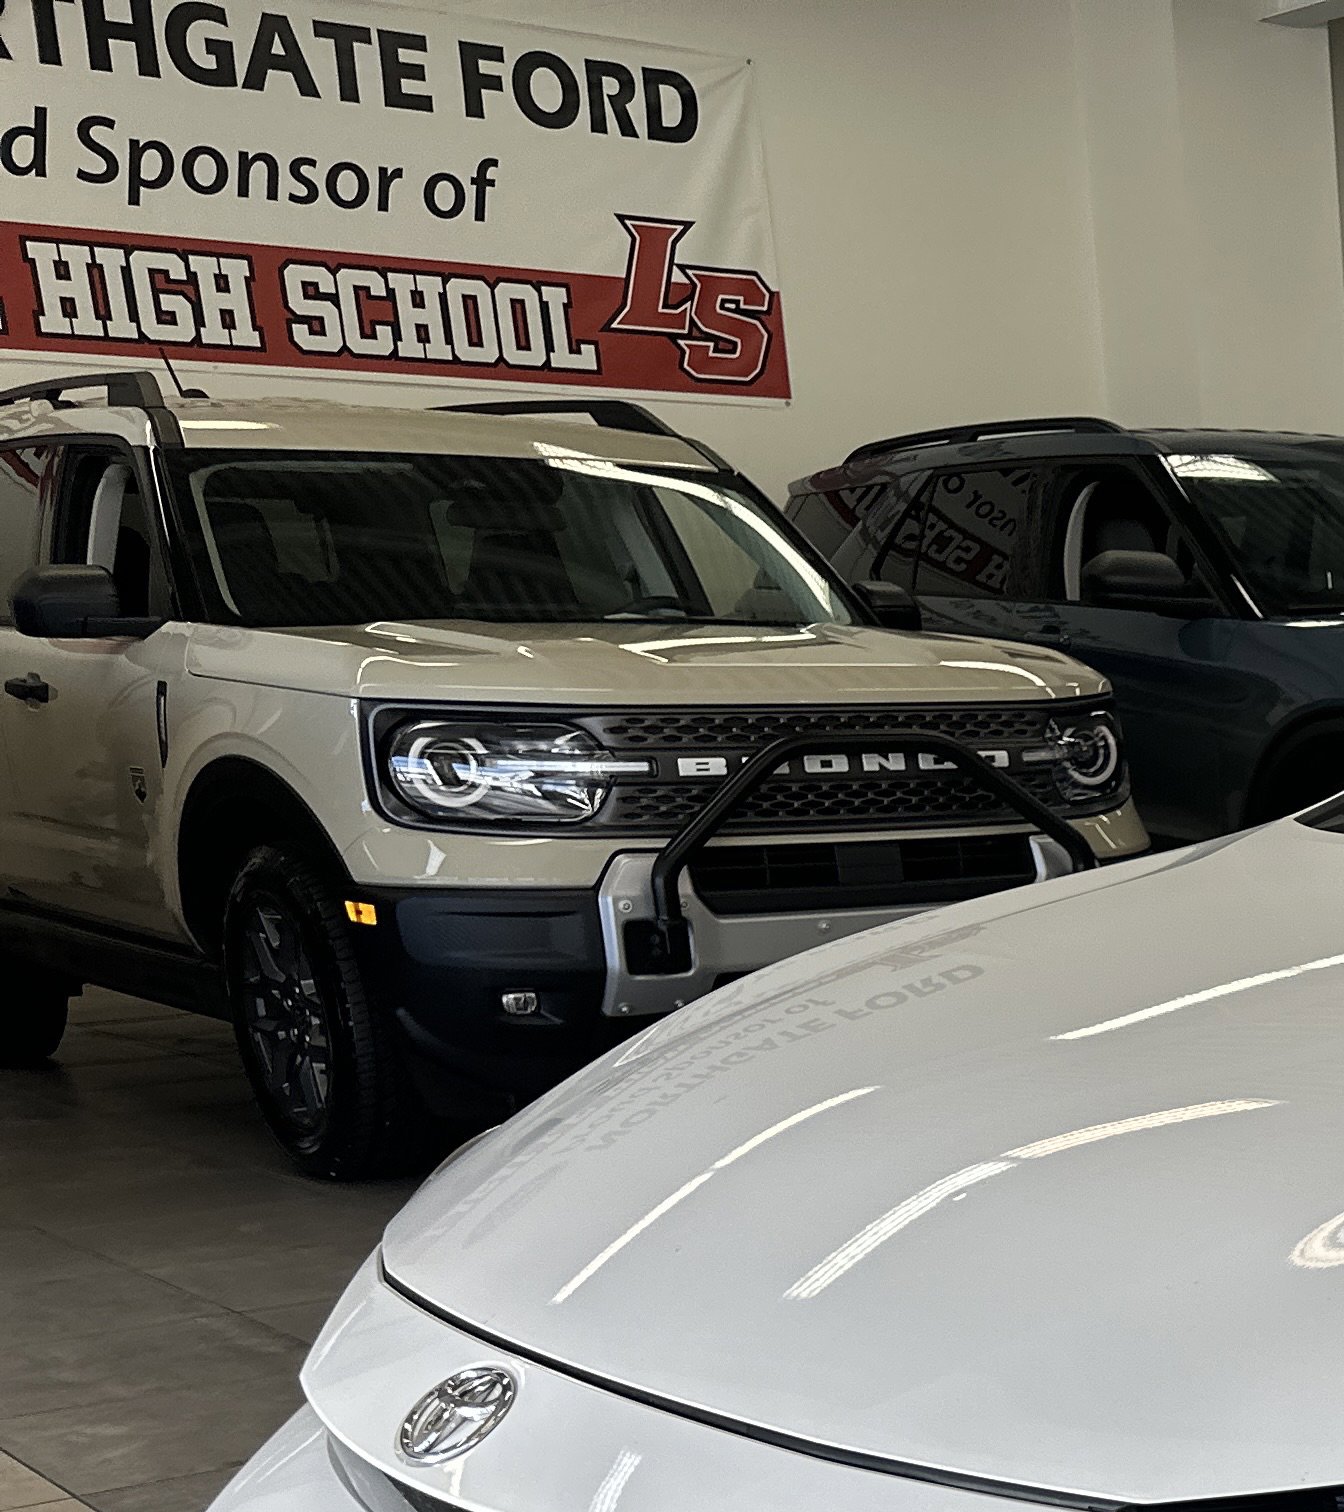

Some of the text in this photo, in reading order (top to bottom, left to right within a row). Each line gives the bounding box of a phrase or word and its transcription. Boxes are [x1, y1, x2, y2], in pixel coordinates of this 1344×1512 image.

[0, 0, 699, 144] THGATE FORD
[76, 115, 404, 213] Sponsor
[422, 157, 500, 223] of
[21, 237, 601, 373] HIGH SCHOOL
[599, 212, 777, 385] LS
[677, 749, 1010, 778] BONCO
